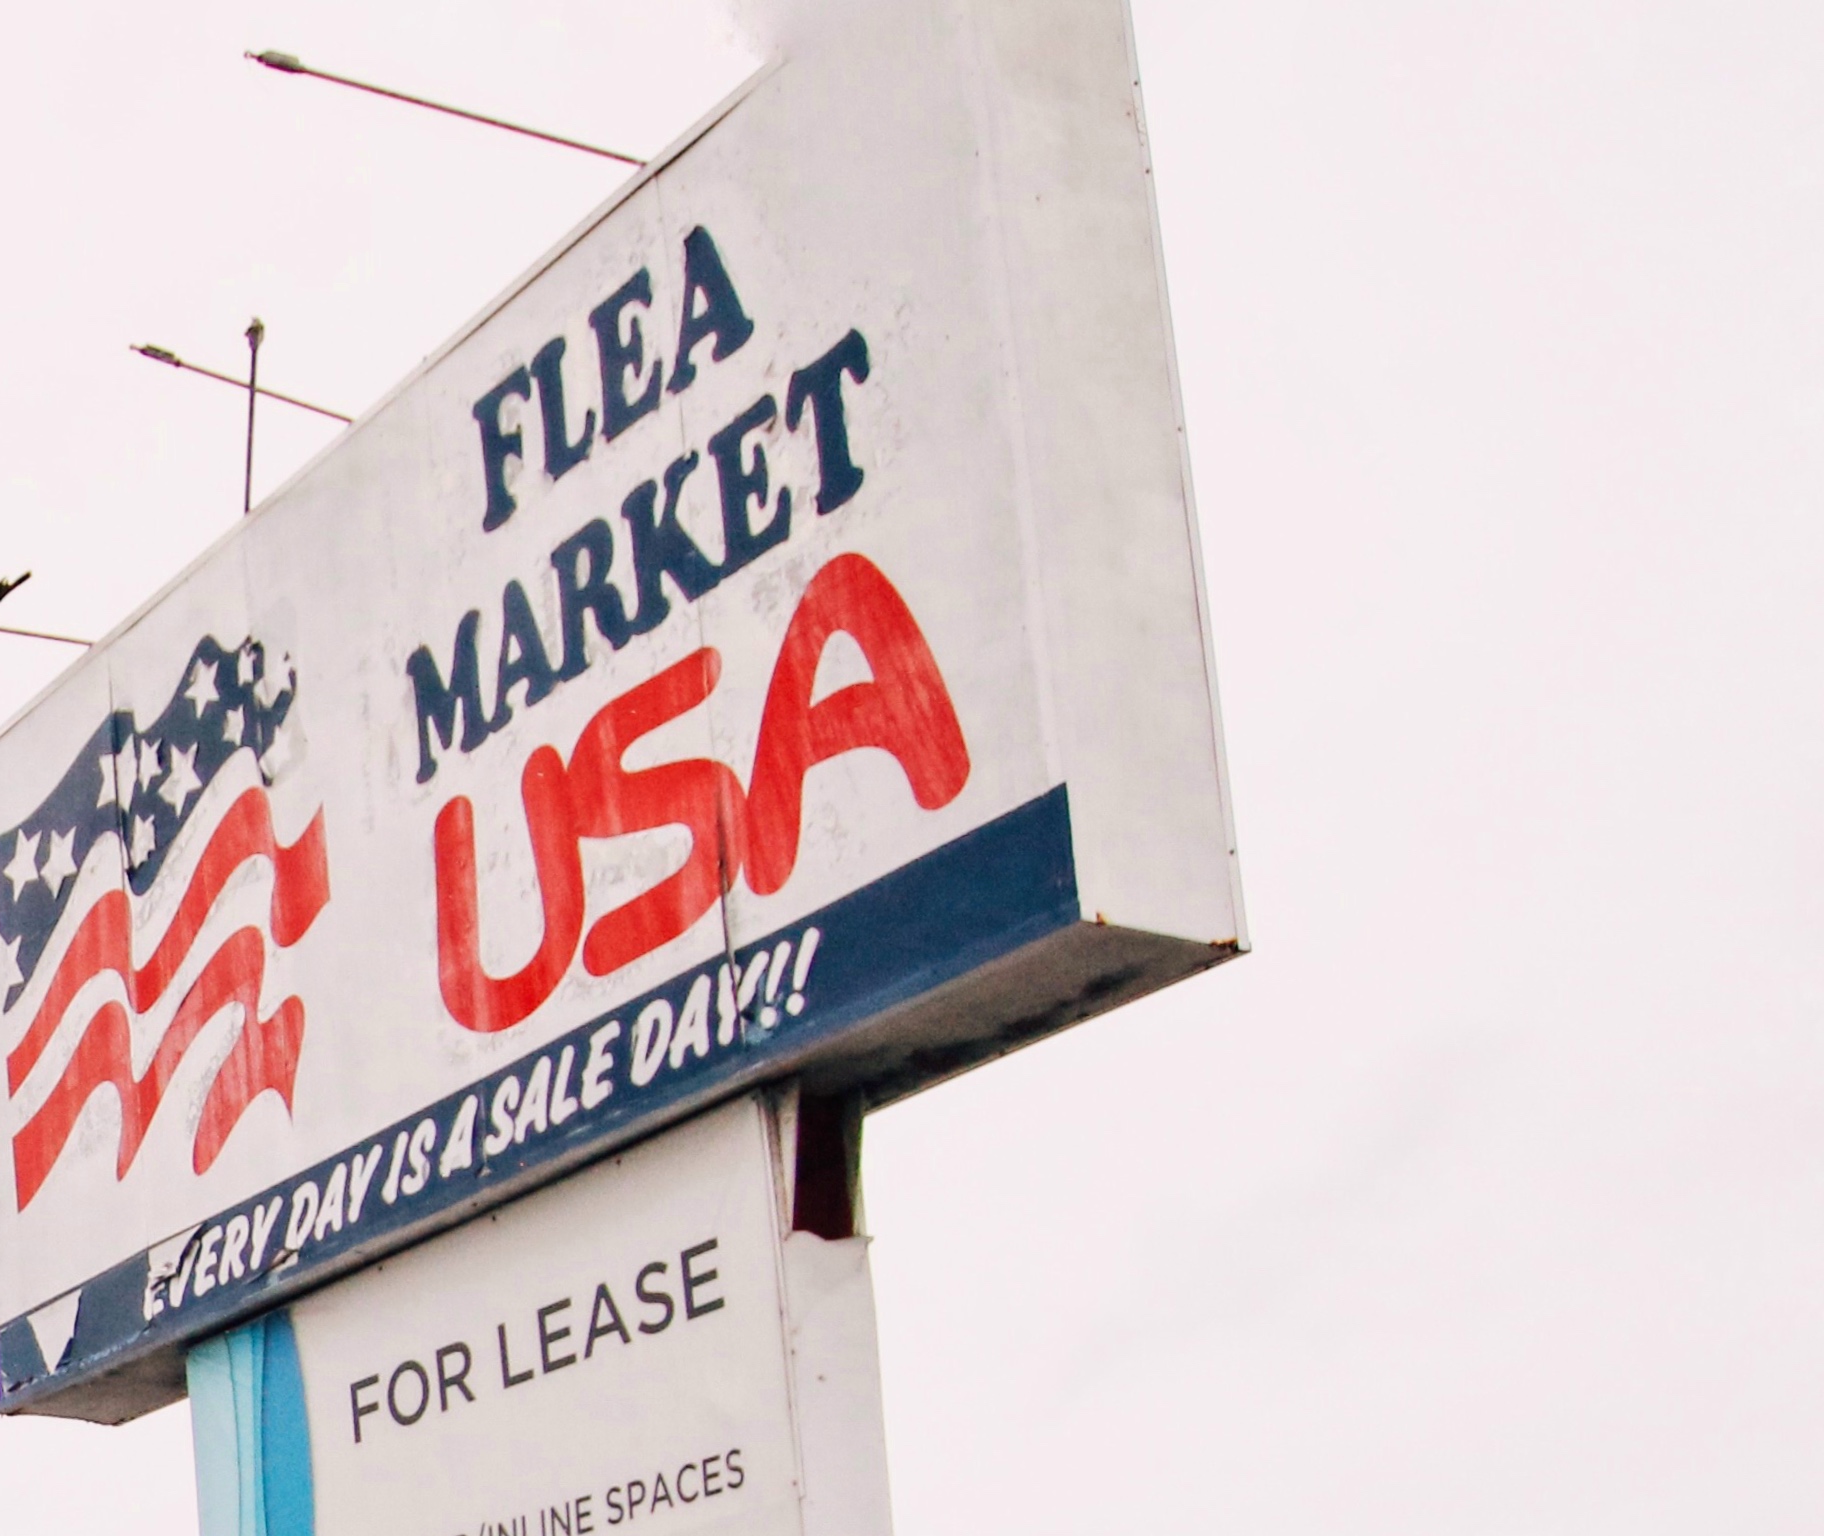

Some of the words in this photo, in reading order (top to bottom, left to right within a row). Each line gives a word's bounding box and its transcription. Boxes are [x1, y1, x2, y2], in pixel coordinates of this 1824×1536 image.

[473, 225, 754, 532] FLEA
[407, 328, 869, 783] MARKET
[434, 553, 970, 1033] USA
[142, 1196, 284, 1320] EVERY
[287, 1144, 381, 1252] DAY
[382, 1116, 436, 1203] IS
[440, 1096, 480, 1178] A
[484, 1021, 617, 1157] SALE
[349, 1341, 476, 1443] FOR
[498, 1237, 725, 1389] LEASE
[606, 1448, 746, 1525] SPACES
